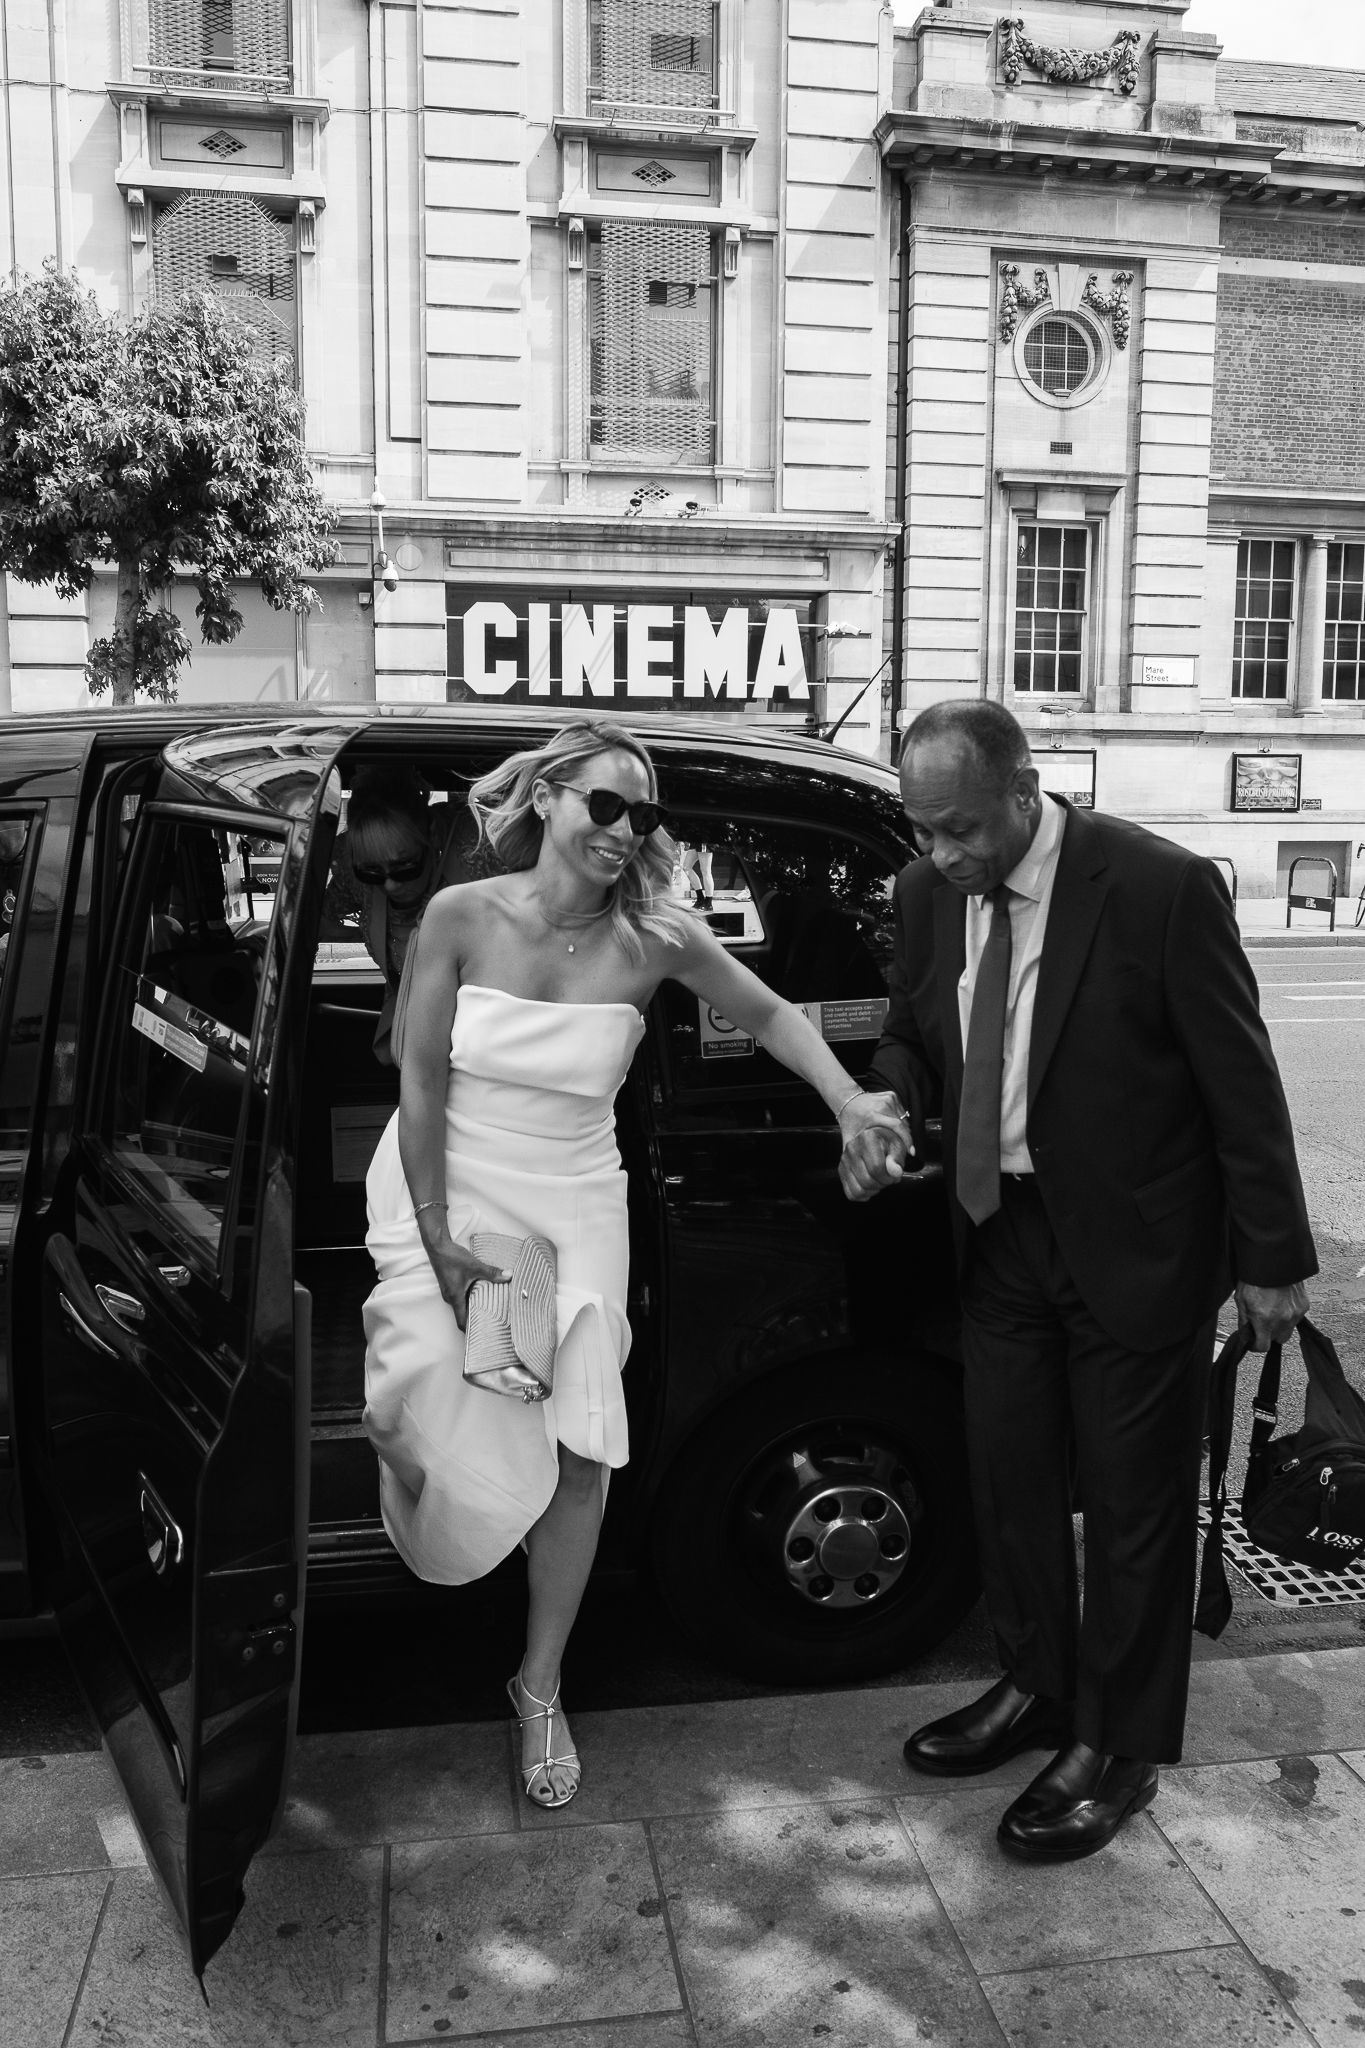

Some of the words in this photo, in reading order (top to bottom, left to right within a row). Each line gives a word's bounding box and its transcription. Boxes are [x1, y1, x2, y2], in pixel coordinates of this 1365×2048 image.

[463, 601, 810, 700] CINEMA
[1145, 666, 1164, 674] Mare
[1145, 674, 1169, 682] Street
[720, 1040, 748, 1049] smoking
